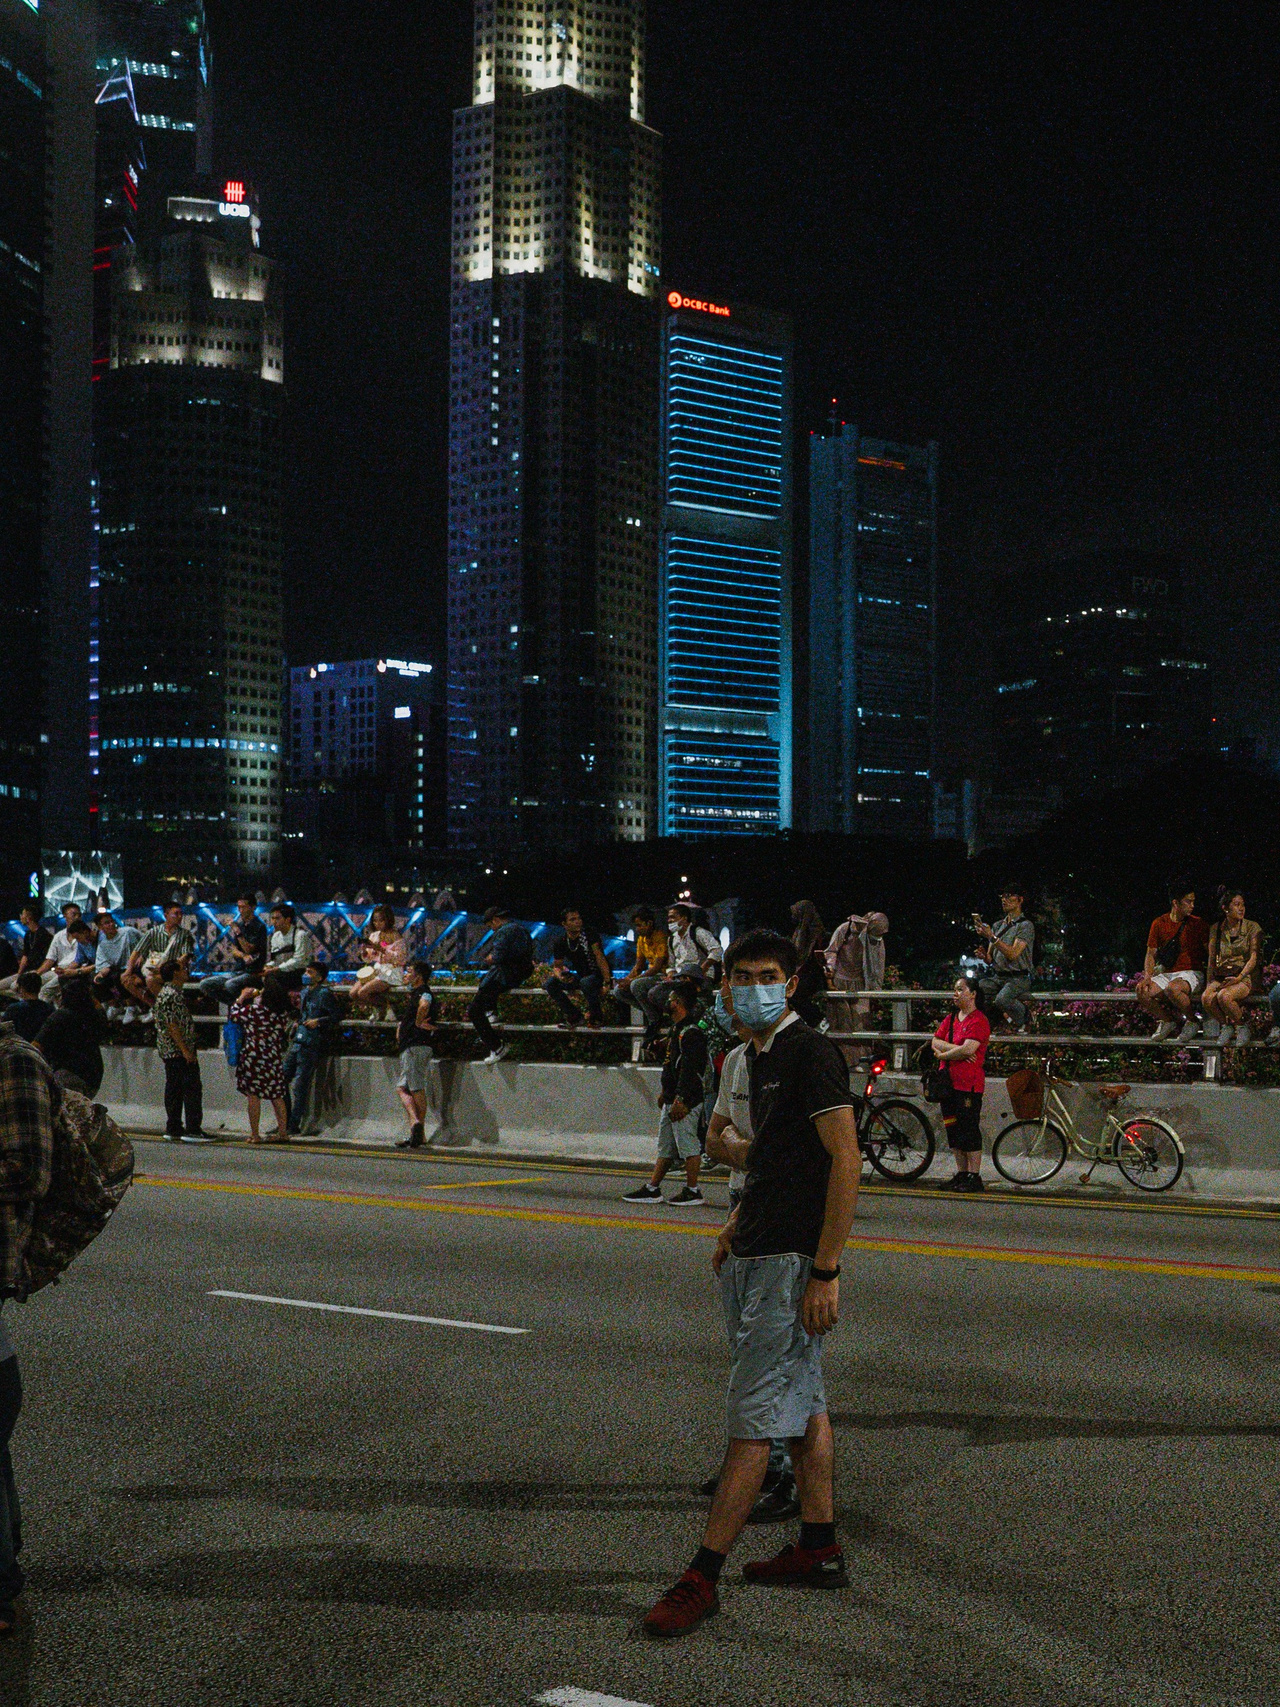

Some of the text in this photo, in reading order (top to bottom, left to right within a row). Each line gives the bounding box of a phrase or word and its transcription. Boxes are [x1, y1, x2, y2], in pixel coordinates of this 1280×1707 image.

[219, 203, 251, 218] UOB
[682, 297, 731, 317] OCBC Bank
